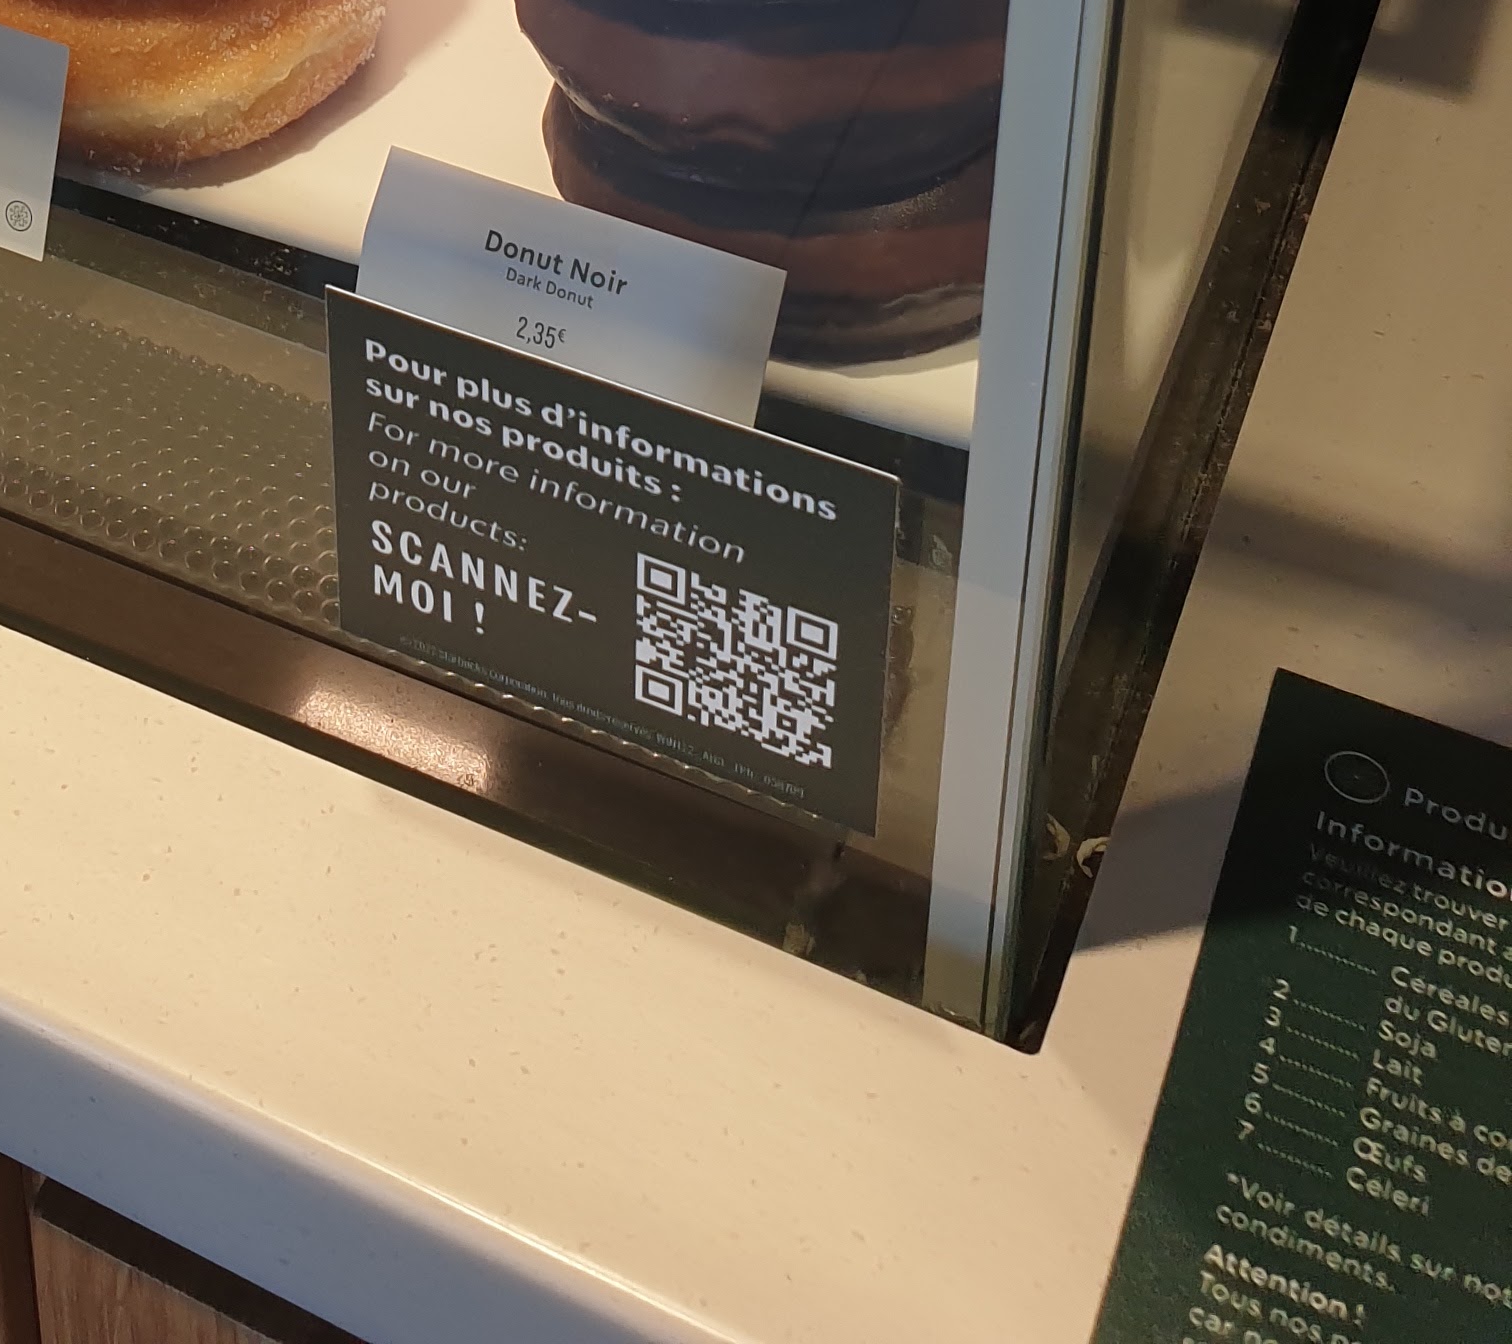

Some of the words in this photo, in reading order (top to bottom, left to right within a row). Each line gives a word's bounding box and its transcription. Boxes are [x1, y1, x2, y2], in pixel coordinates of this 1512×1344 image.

[484, 229, 562, 276] Donut
[569, 261, 628, 297] Noir
[506, 267, 541, 292] Dark
[545, 282, 594, 310] Donut
[515, 316, 566, 350] 2,35€
[365, 339, 447, 385] Pour
[457, 377, 531, 415] plus
[541, 402, 837, 521] d’informations
[366, 379, 418, 408] sur
[429, 400, 491, 435] nos
[502, 425, 661, 497] produits
[367, 412, 419, 445] For
[428, 439, 518, 482] more
[529, 469, 746, 564] information
[368, 456, 409, 476] on
[420, 470, 475, 497] our
[369, 480, 527, 552] products:
[371, 519, 597, 624] SCANNEZ-
[373, 564, 453, 623] MOI
[1316, 811, 1512, 899] Informatio
[1289, 924, 1298, 944] 1
[1335, 909, 1432, 958] chaque
[1412, 884, 1508, 932] trouver
[1272, 978, 1290, 1001] 2
[1378, 1018, 1436, 1059] Soja
[1384, 995, 1420, 1022] du
[1258, 1036, 1275, 1055] 4
[1264, 1006, 1282, 1027] 3
[1372, 1048, 1424, 1086] Lait
[1238, 1118, 1255, 1140] 7
[1244, 1091, 1262, 1114] 6
[1251, 1062, 1270, 1084] 5
[1359, 1106, 1469, 1168] Graines
[1204, 1243, 1348, 1320] Attention
